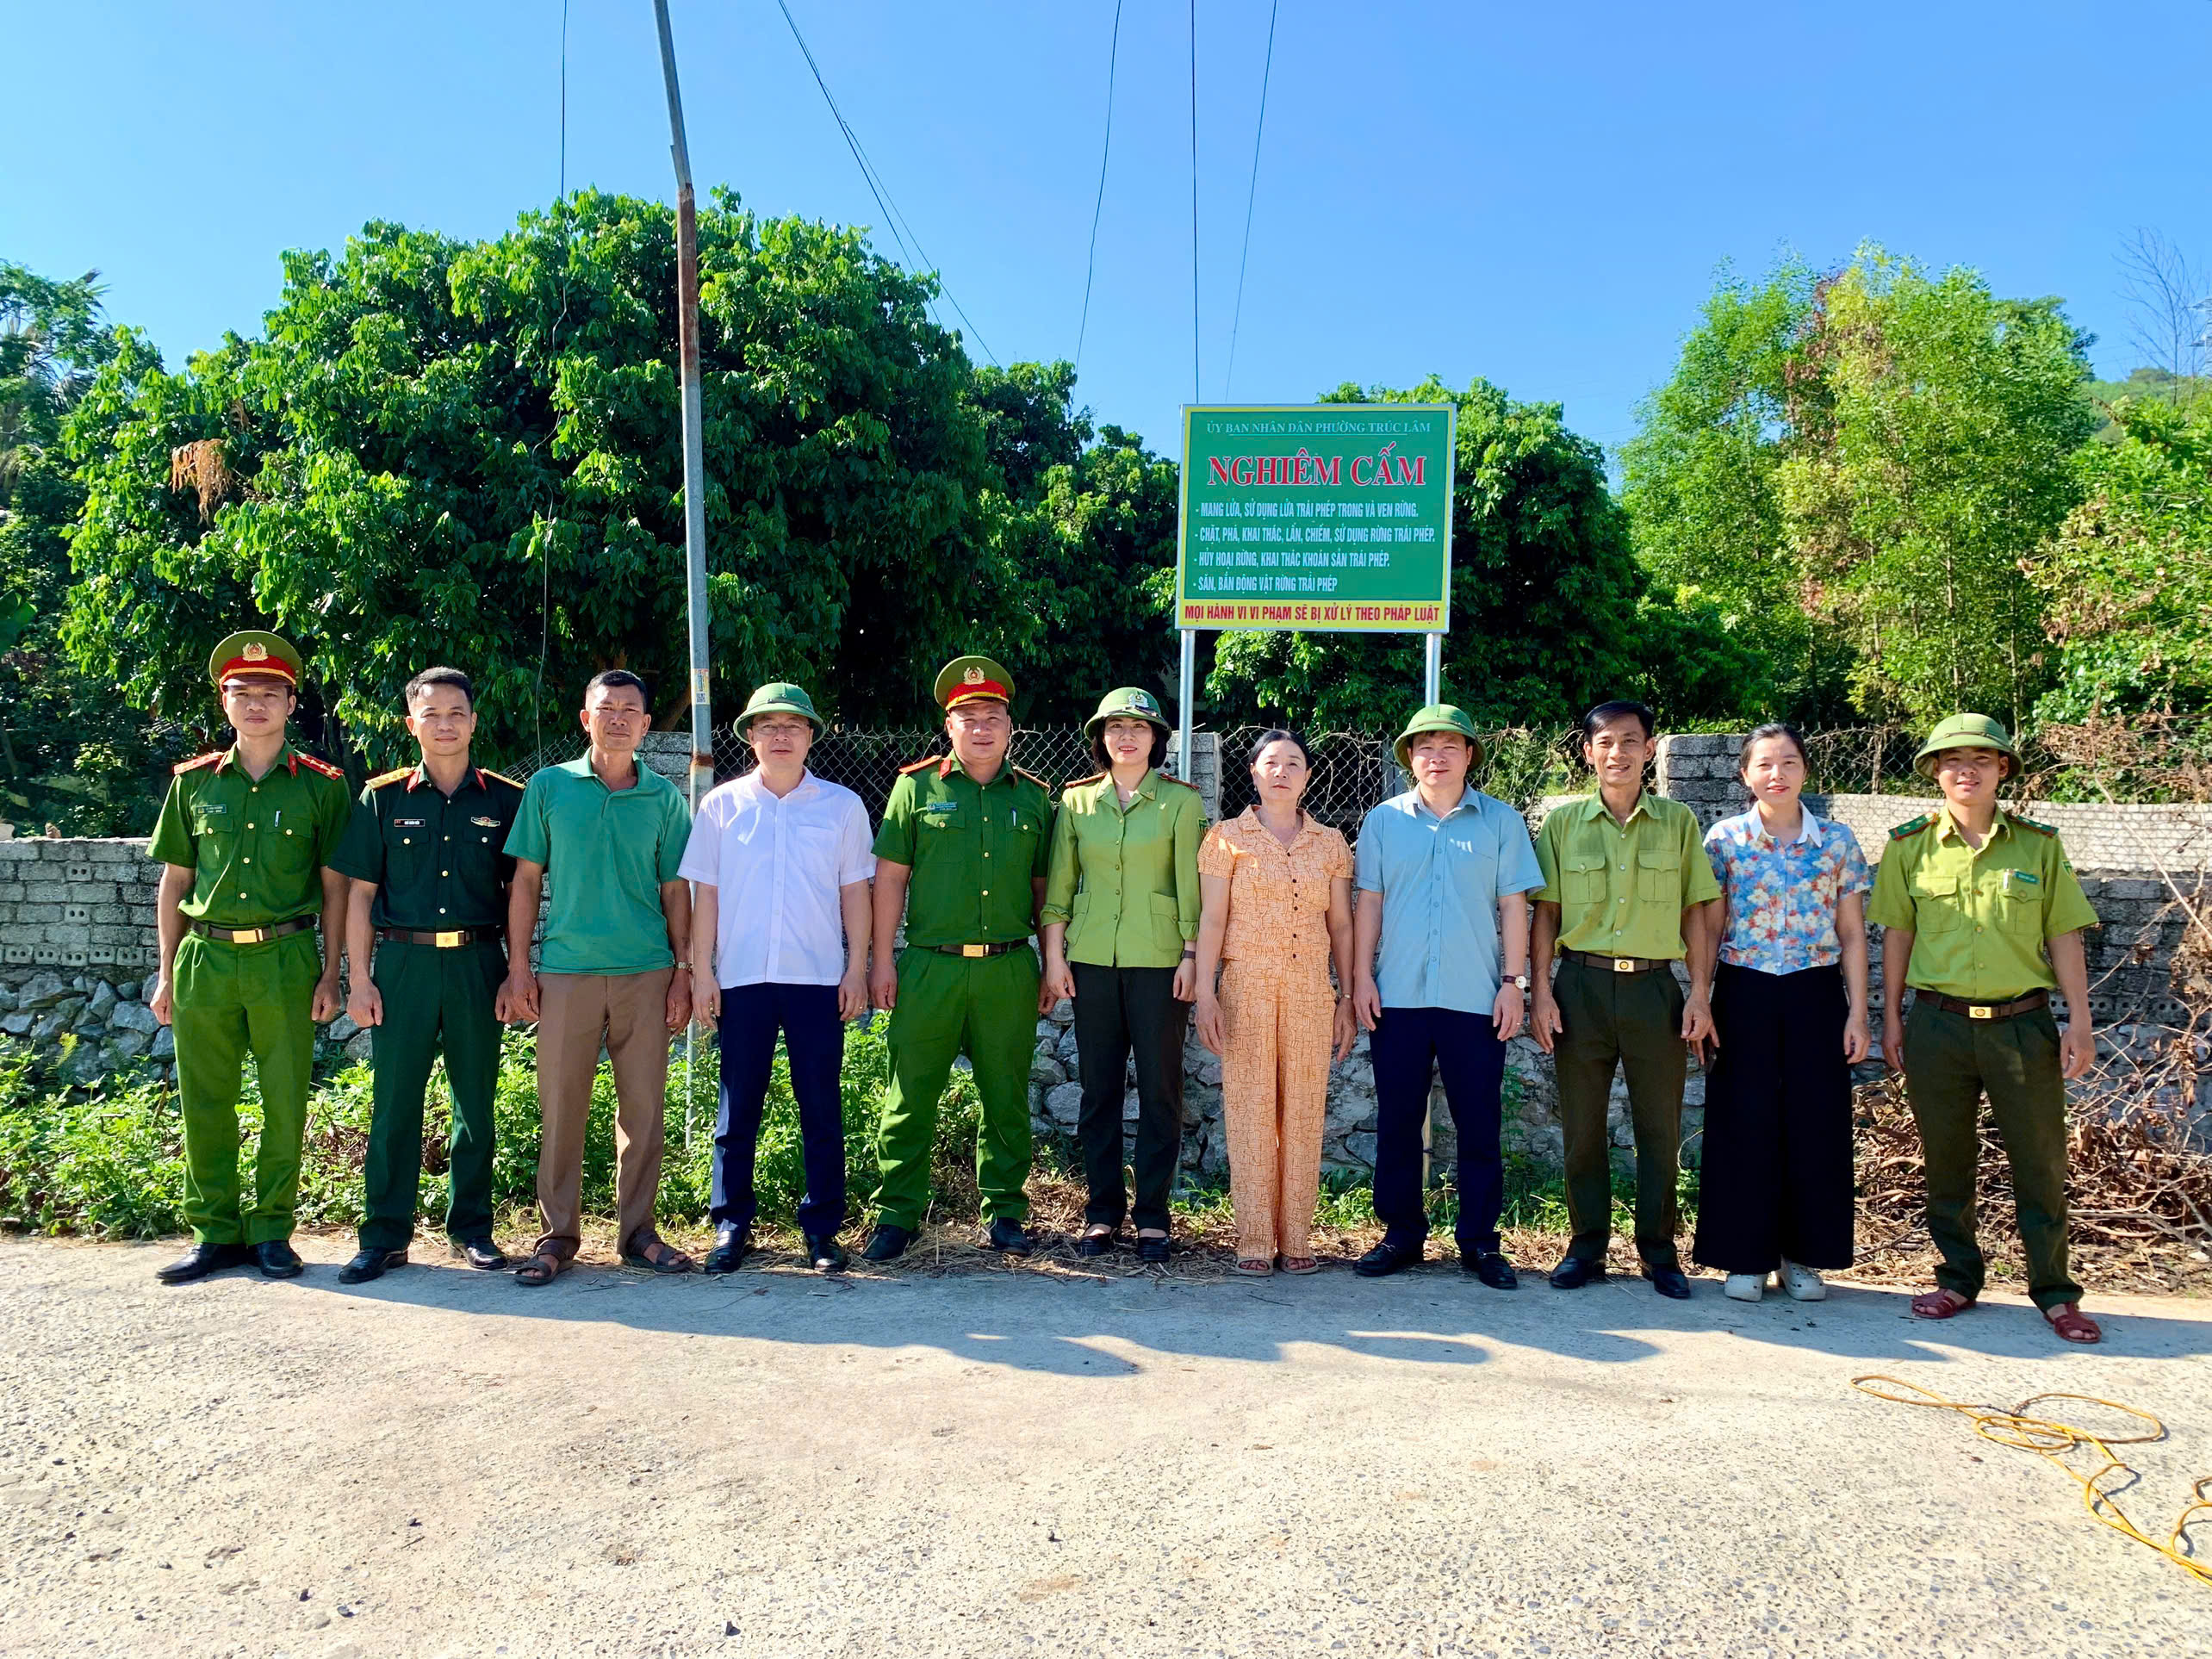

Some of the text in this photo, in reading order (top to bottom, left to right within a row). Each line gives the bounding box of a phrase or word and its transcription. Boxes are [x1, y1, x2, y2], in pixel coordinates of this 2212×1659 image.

[1226, 423, 1249, 433] BAN
[1252, 421, 1285, 433] NHÂN
[1315, 420, 1365, 433] PHƯỜNG
[1369, 420, 1401, 432] TRÚC
[1404, 420, 1431, 432] LÂM
[1207, 441, 1427, 487] NGHIÊM CẤM
[1200, 502, 1224, 517] MANG
[1244, 498, 1256, 517] SỬ
[1257, 502, 1278, 520] DỤNG
[1296, 500, 1314, 517] TRÁI
[1315, 500, 1336, 518] PHÉP
[1338, 502, 1364, 518] TRONG
[1365, 500, 1376, 518] VÀ
[1377, 502, 1393, 518] VEN
[1395, 500, 1419, 518] RỪNG.
[1222, 525, 1240, 544] PHÁ,
[1242, 527, 1260, 542] KHAI
[1262, 525, 1283, 544] THÁC,
[1305, 523, 1333, 544] CHIẾM,
[1334, 523, 1345, 542] SỬ
[1346, 527, 1369, 545] DỤNG
[1370, 525, 1393, 542] RỪNG
[1394, 525, 1412, 542] TRÁI
[1414, 525, 1435, 543] PHÉP.
[1199, 547, 1214, 566] HỦY
[1215, 551, 1234, 569] HOẠI
[1235, 549, 1259, 568] RỪNG,
[1261, 552, 1279, 567] KHAI
[1281, 550, 1301, 567] THÁC
[1331, 548, 1347, 567] SẢN
[1349, 550, 1366, 567] TRÁI
[1368, 550, 1390, 567] PHÉP.
[1235, 574, 1257, 594] ĐỘNG
[1259, 574, 1273, 594] VẬT
[1275, 574, 1296, 591] RỪNG
[1317, 575, 1338, 592] PHÉP
[1184, 602, 1440, 624] MỌI HÀNH VI VI PHẠM SẼ BỊ XỬ LÝ THEO PHÁP LUẬT
